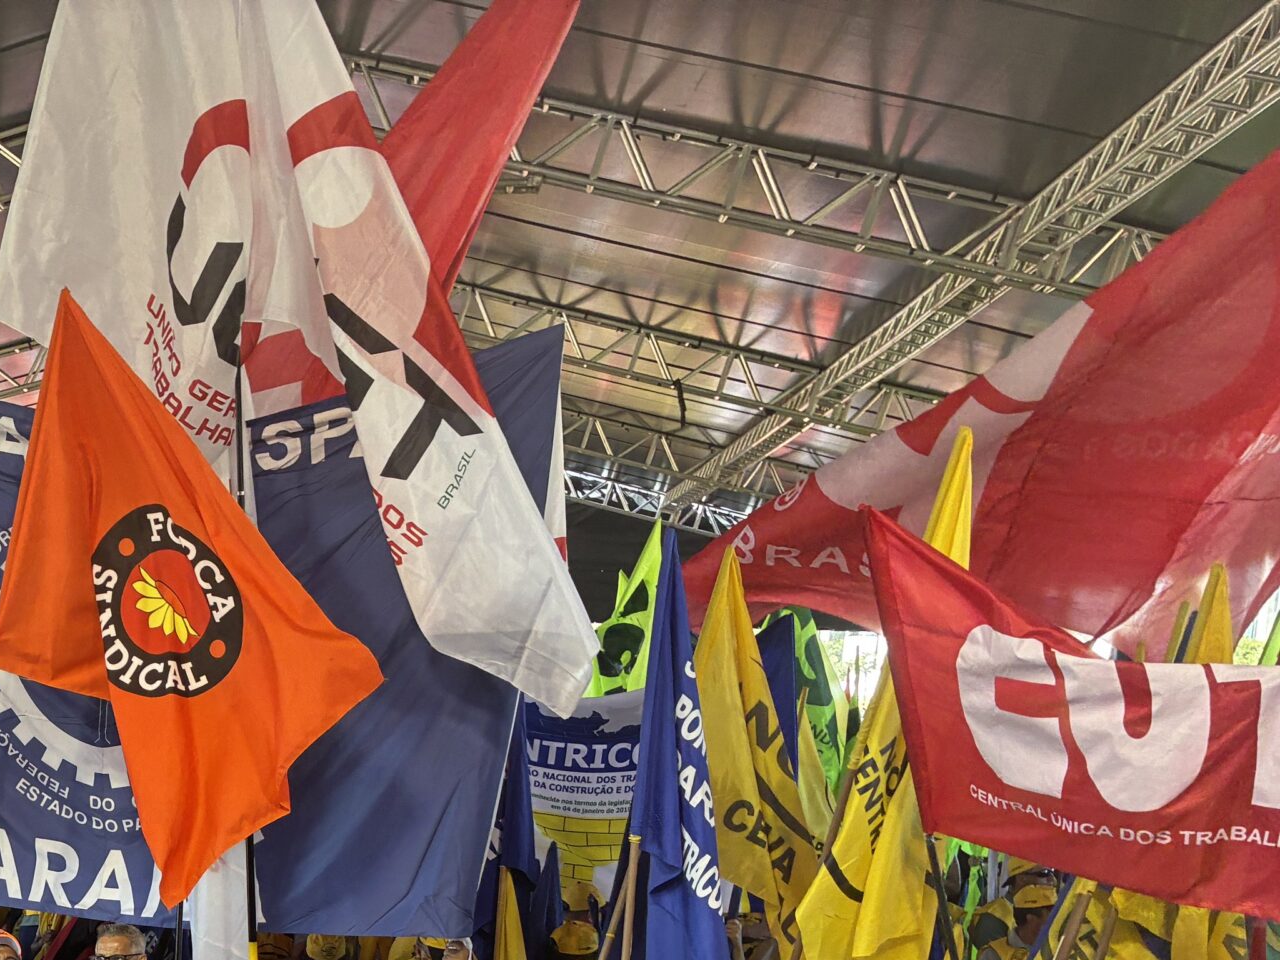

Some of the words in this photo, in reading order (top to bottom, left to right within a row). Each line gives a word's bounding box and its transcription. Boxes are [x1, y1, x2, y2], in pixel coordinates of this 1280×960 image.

[437, 449, 476, 510] BRASIL
[16, 778, 87, 826] ESTADO
[92, 815, 118, 833] DO
[534, 780, 546, 788] DA
[548, 783, 613, 796] CONSTRUÇÃO
[616, 786, 622, 794] E
[542, 771, 592, 784] NACIONAL
[596, 775, 616, 785] DOS
[970, 784, 1048, 822] CENTRAL
[1050, 812, 1113, 838] ÚNICA
[1119, 827, 1172, 846] DOS
